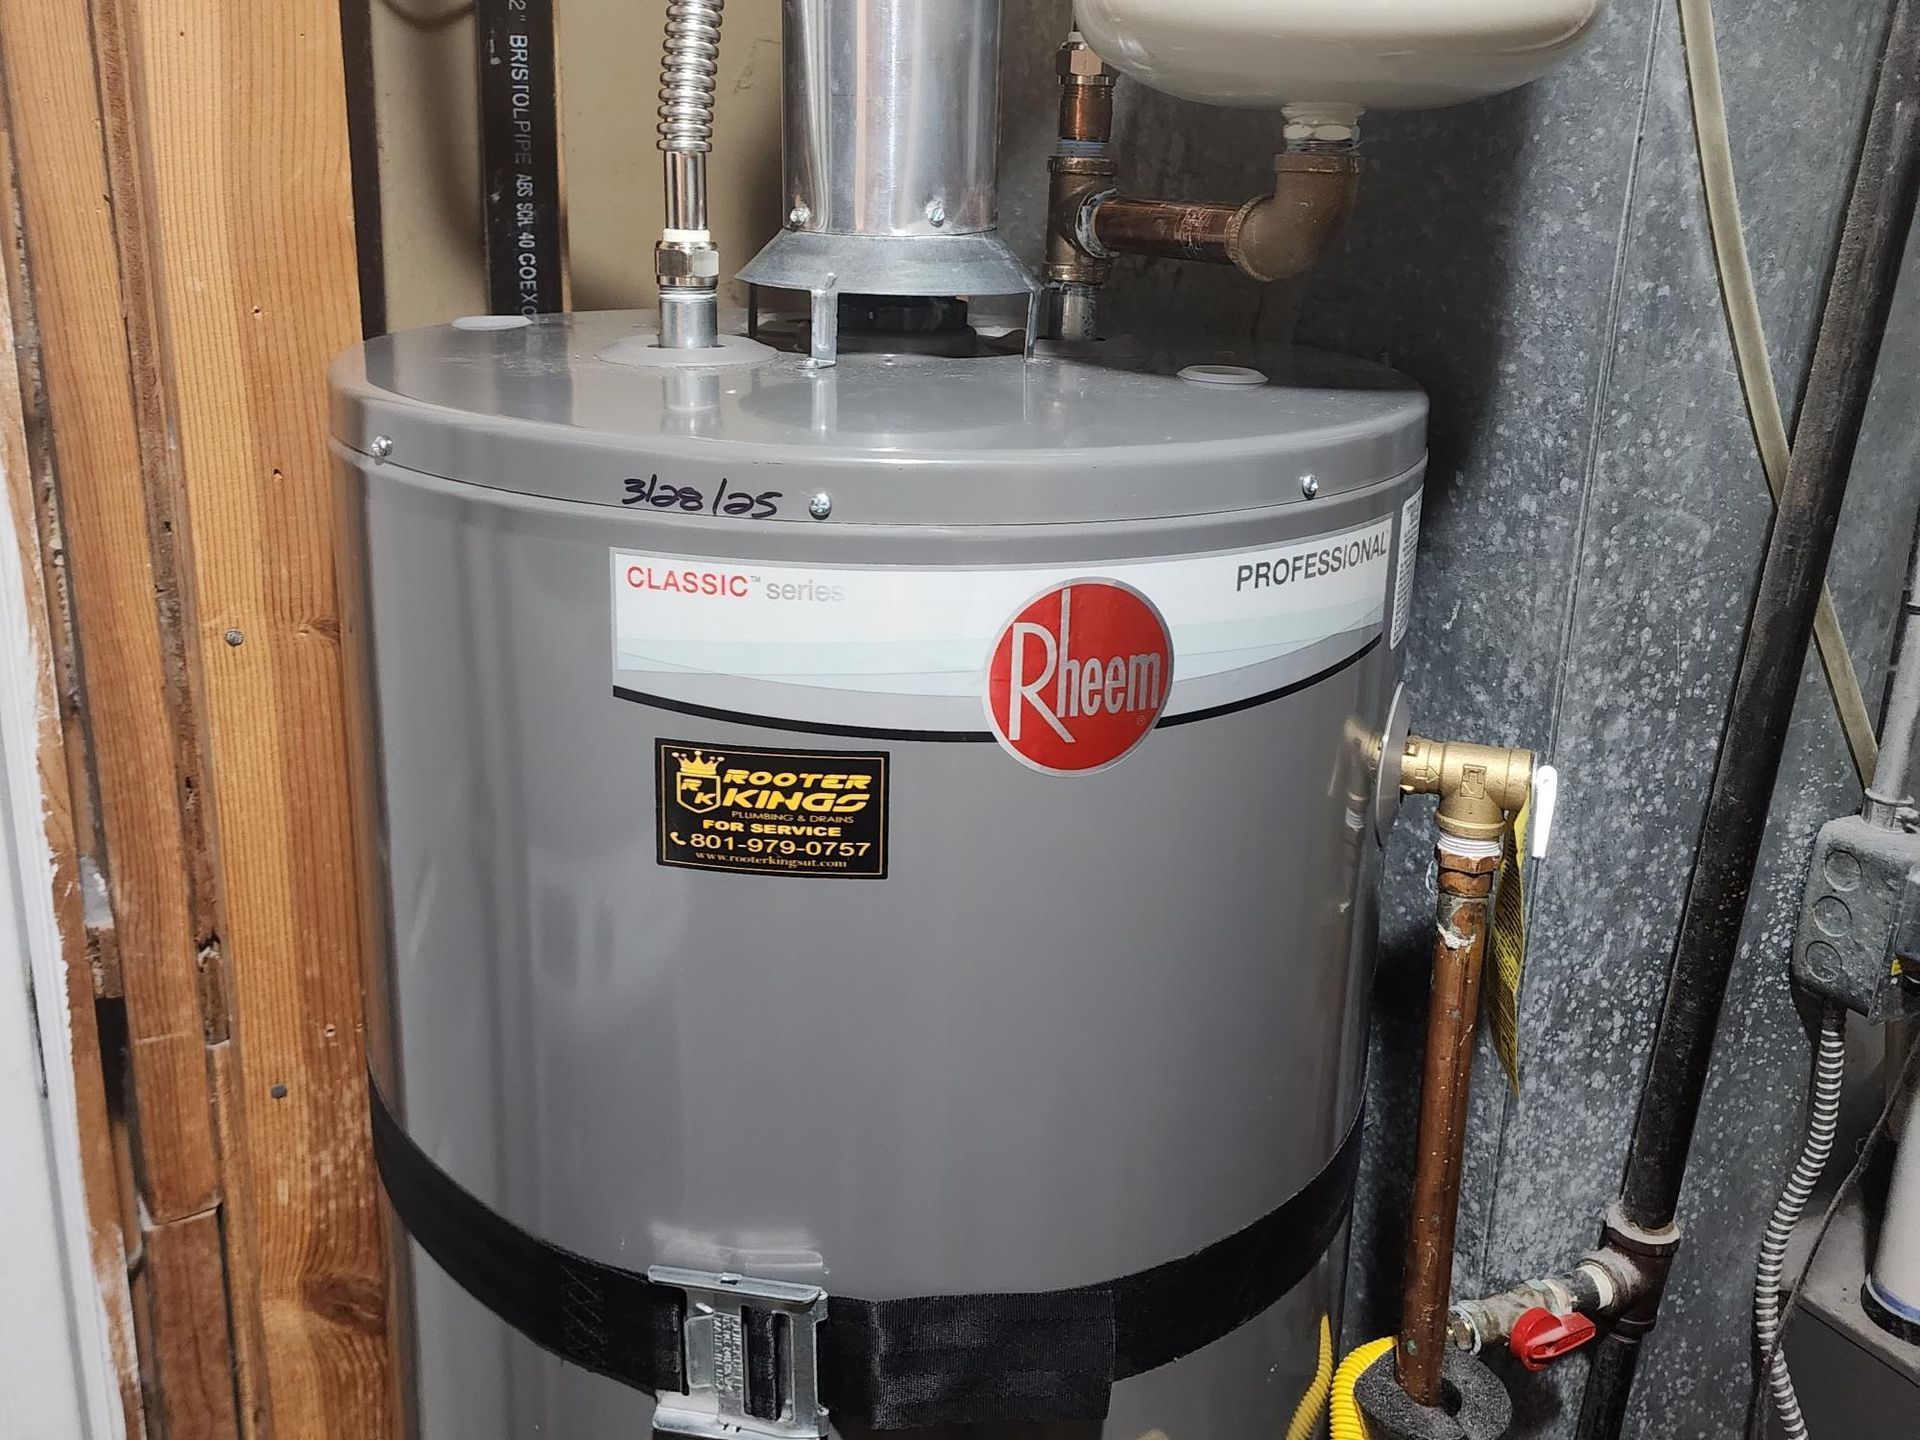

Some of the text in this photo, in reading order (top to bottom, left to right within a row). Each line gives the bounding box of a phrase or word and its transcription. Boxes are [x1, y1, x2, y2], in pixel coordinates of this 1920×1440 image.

[516, 173, 533, 197] ABS
[518, 232, 535, 249] 40
[622, 473, 783, 518] 3/28/25
[1236, 531, 1387, 592] PROFESSIONAL
[766, 579, 846, 602] series
[723, 768, 872, 790] ROOTER
[721, 788, 871, 812] KINGS
[702, 819, 842, 837] FOR SERVICE
[731, 810, 854, 824] PLUMBING & DRAINS
[689, 833, 872, 857] 801-979-0757
[695, 851, 847, 869] www.rooterkingsut.com
